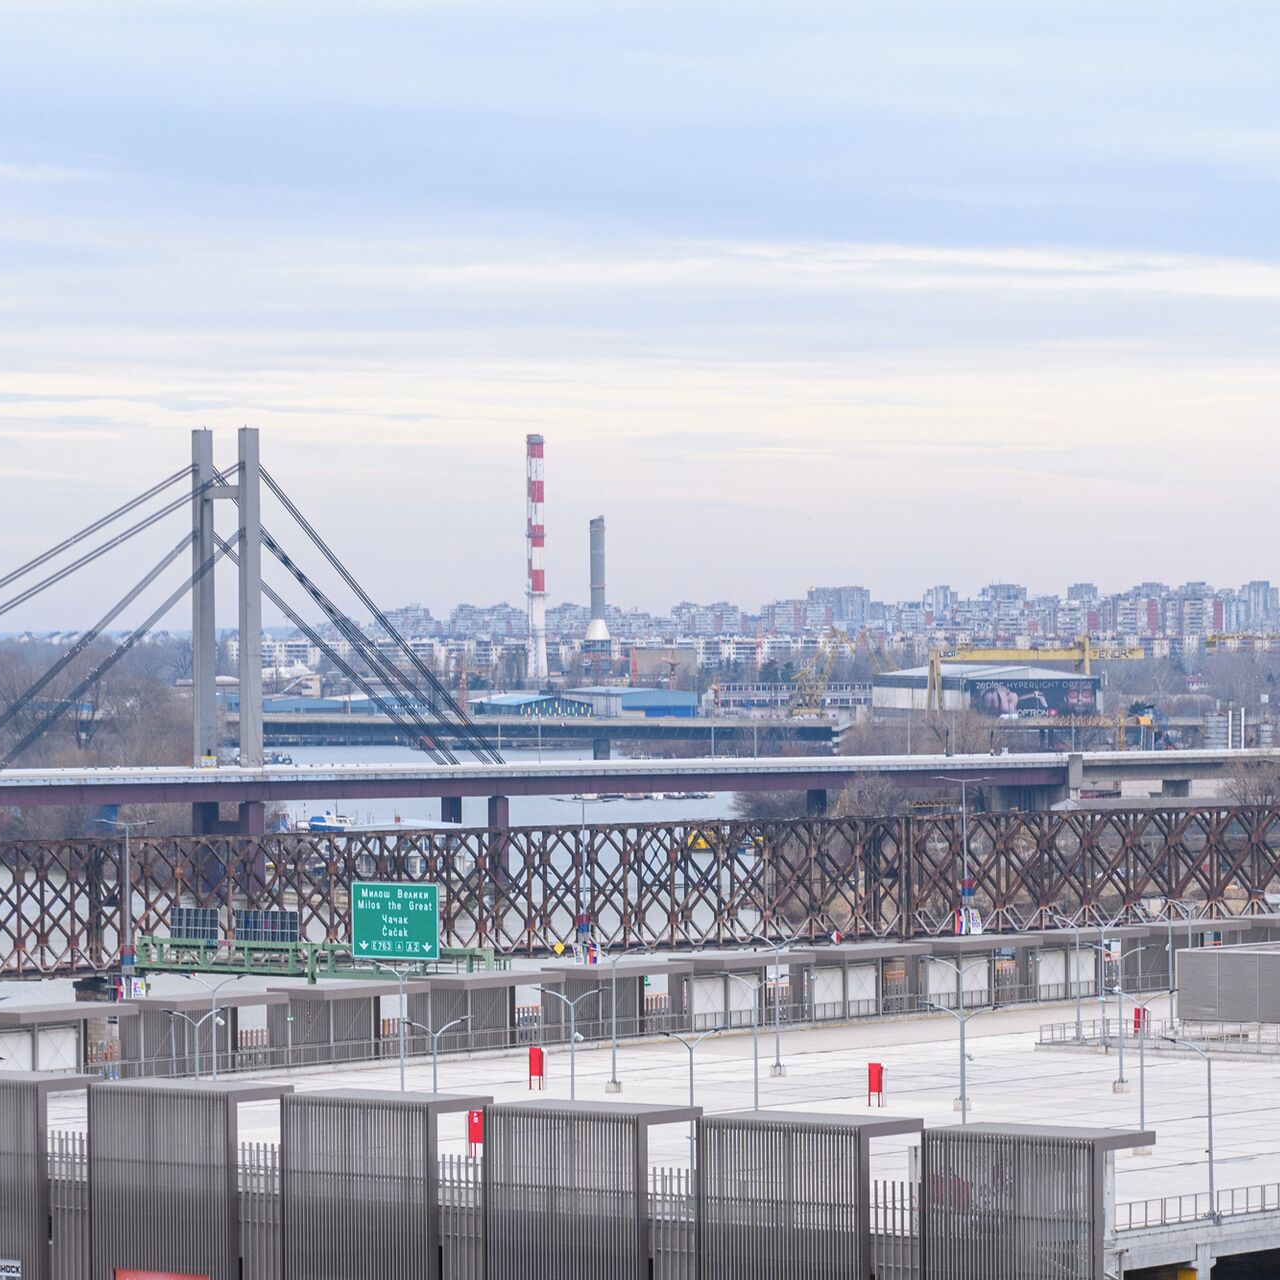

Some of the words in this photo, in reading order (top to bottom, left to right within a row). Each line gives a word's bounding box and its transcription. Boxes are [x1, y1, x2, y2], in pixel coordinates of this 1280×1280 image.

[1006, 680, 1059, 689] HYPERLIGHT
[361, 888, 390, 899] Милош
[397, 889, 429, 900] Велики
[357, 900, 381, 910] Milos
[388, 901, 402, 910] the
[408, 901, 433, 911] Great
[381, 914, 408, 925] Чачак
[381, 925, 408, 937] Čačak
